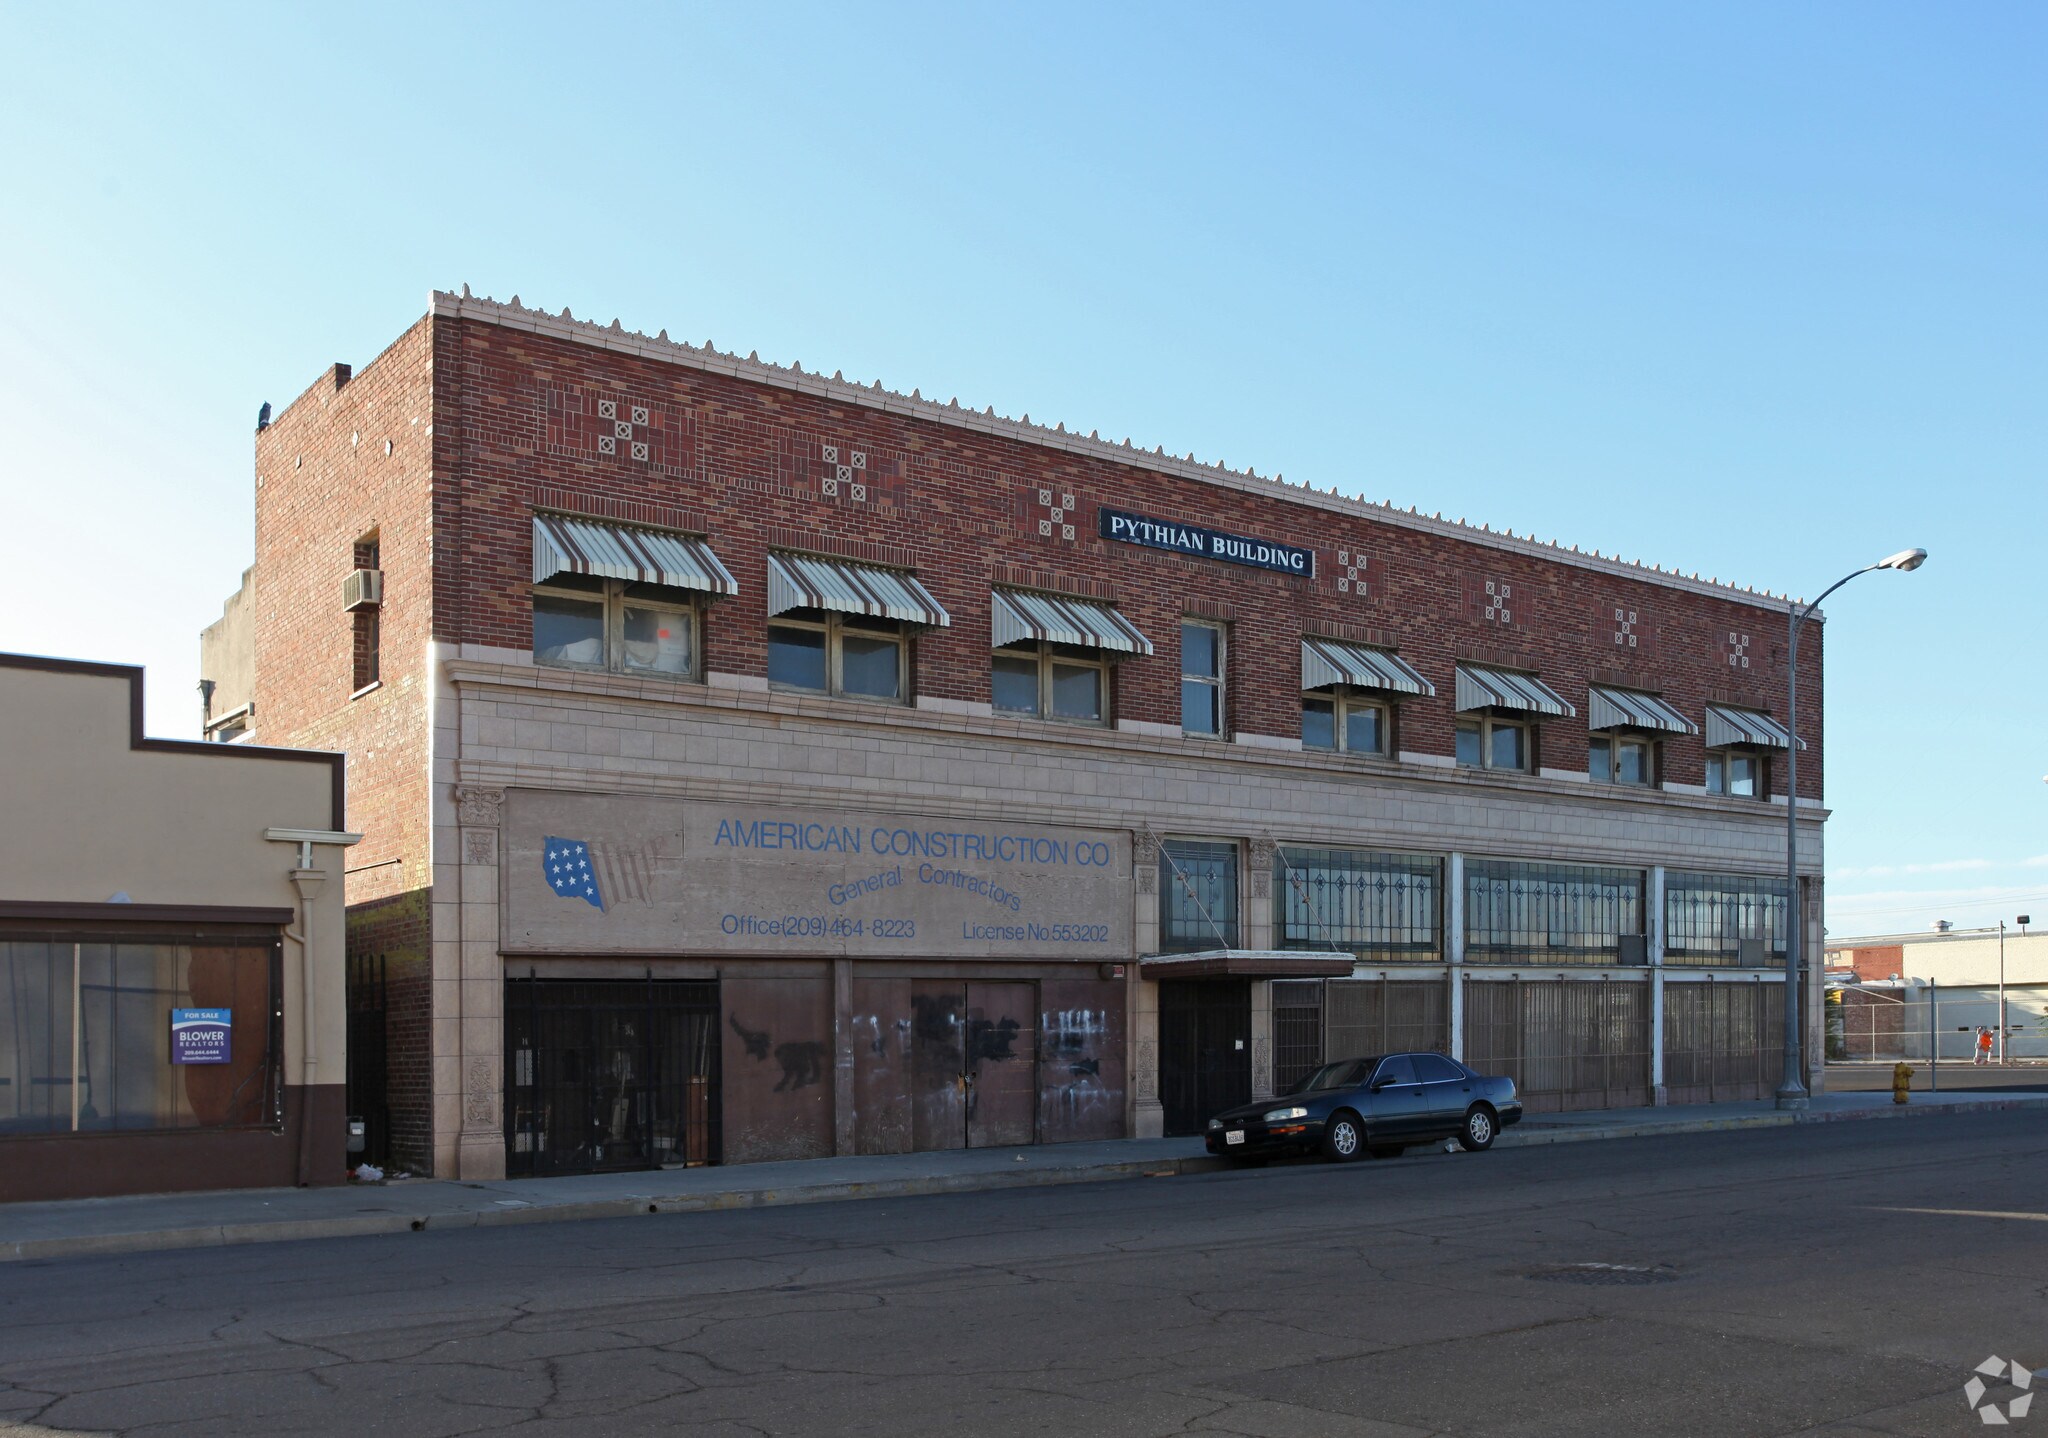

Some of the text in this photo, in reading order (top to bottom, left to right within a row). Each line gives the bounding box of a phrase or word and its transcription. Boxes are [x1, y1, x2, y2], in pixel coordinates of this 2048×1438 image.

[1111, 515, 1304, 570] PYTHIAN BUILDING
[714, 819, 1110, 867] AMERICAN CONSTRUCTION CO
[828, 863, 1021, 911] General Contractors
[963, 921, 1109, 942] License No 553202
[179, 1031, 225, 1041] BLOWER
